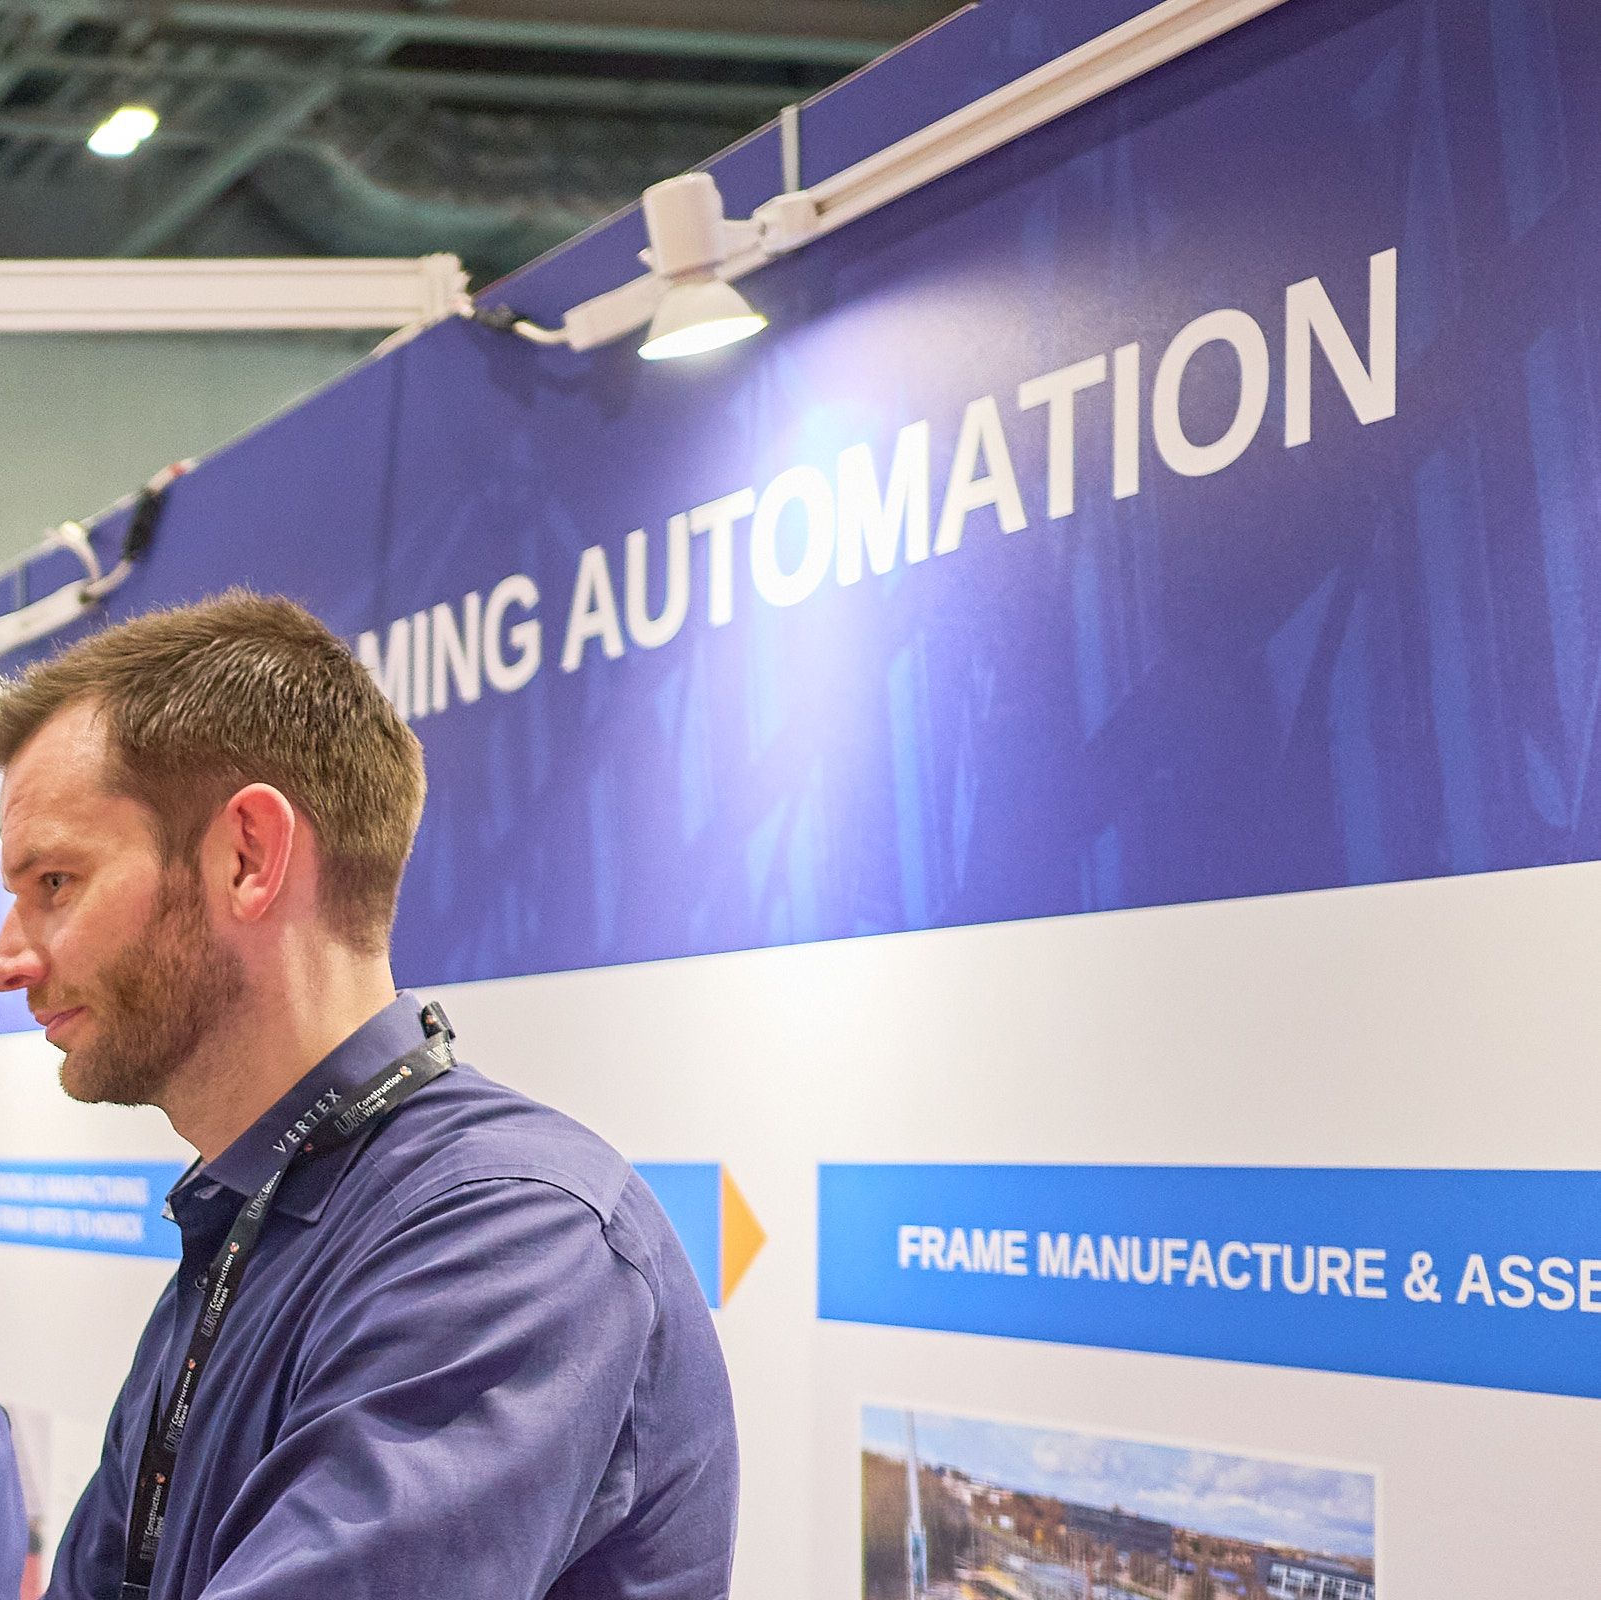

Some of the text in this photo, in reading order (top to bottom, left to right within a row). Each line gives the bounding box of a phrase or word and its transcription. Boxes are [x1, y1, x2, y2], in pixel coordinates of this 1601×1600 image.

[559, 247, 1400, 672] AUTOMATION
[273, 1088, 343, 1155] VERTEX
[334, 1072, 404, 1138] UK Construction
[362, 1096, 388, 1120] Week
[200, 1253, 235, 1338] UK Construction
[897, 1225, 1601, 1313] FRAME MANUFACTURE & ASSE
[215, 1287, 230, 1314] Week
[171, 1370, 193, 1426] Construction
[177, 1403, 190, 1430] Week
[144, 1484, 163, 1537] Construction
